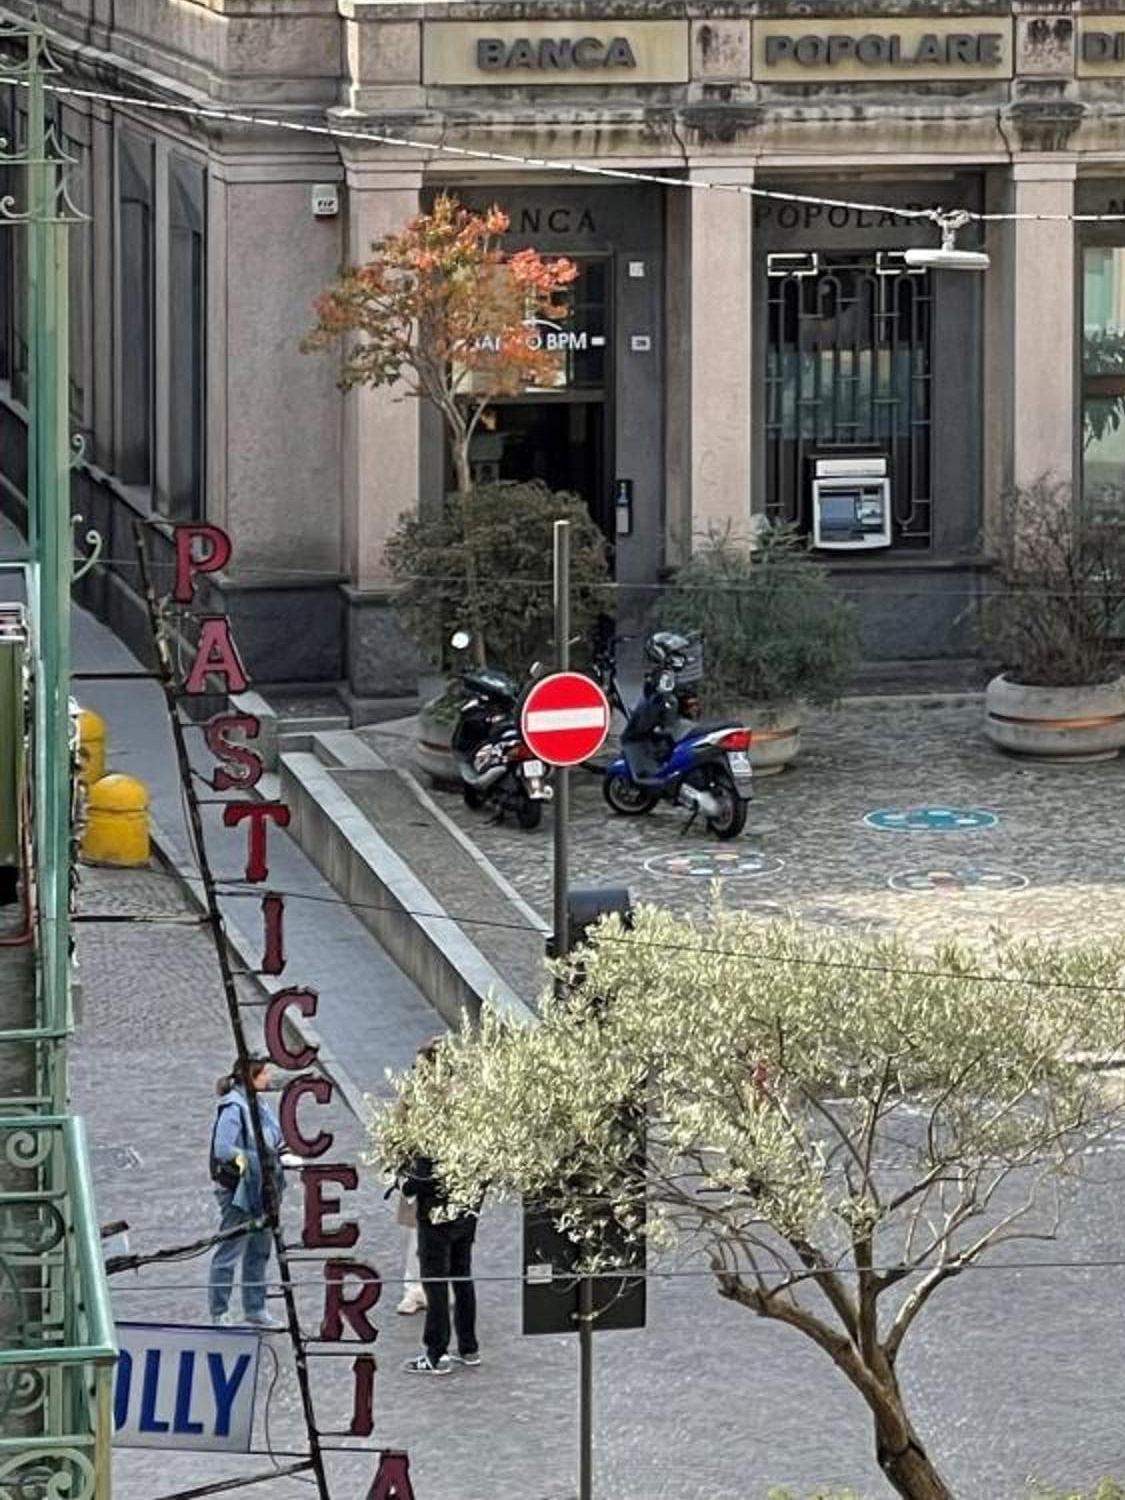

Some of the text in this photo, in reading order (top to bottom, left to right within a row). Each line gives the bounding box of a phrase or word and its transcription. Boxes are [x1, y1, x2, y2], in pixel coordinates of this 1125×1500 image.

[477, 36, 637, 70] BANCA
[765, 33, 1003, 68] POPOLARE
[1082, 31, 1125, 62] DI
[547, 332, 587, 351] BPM
